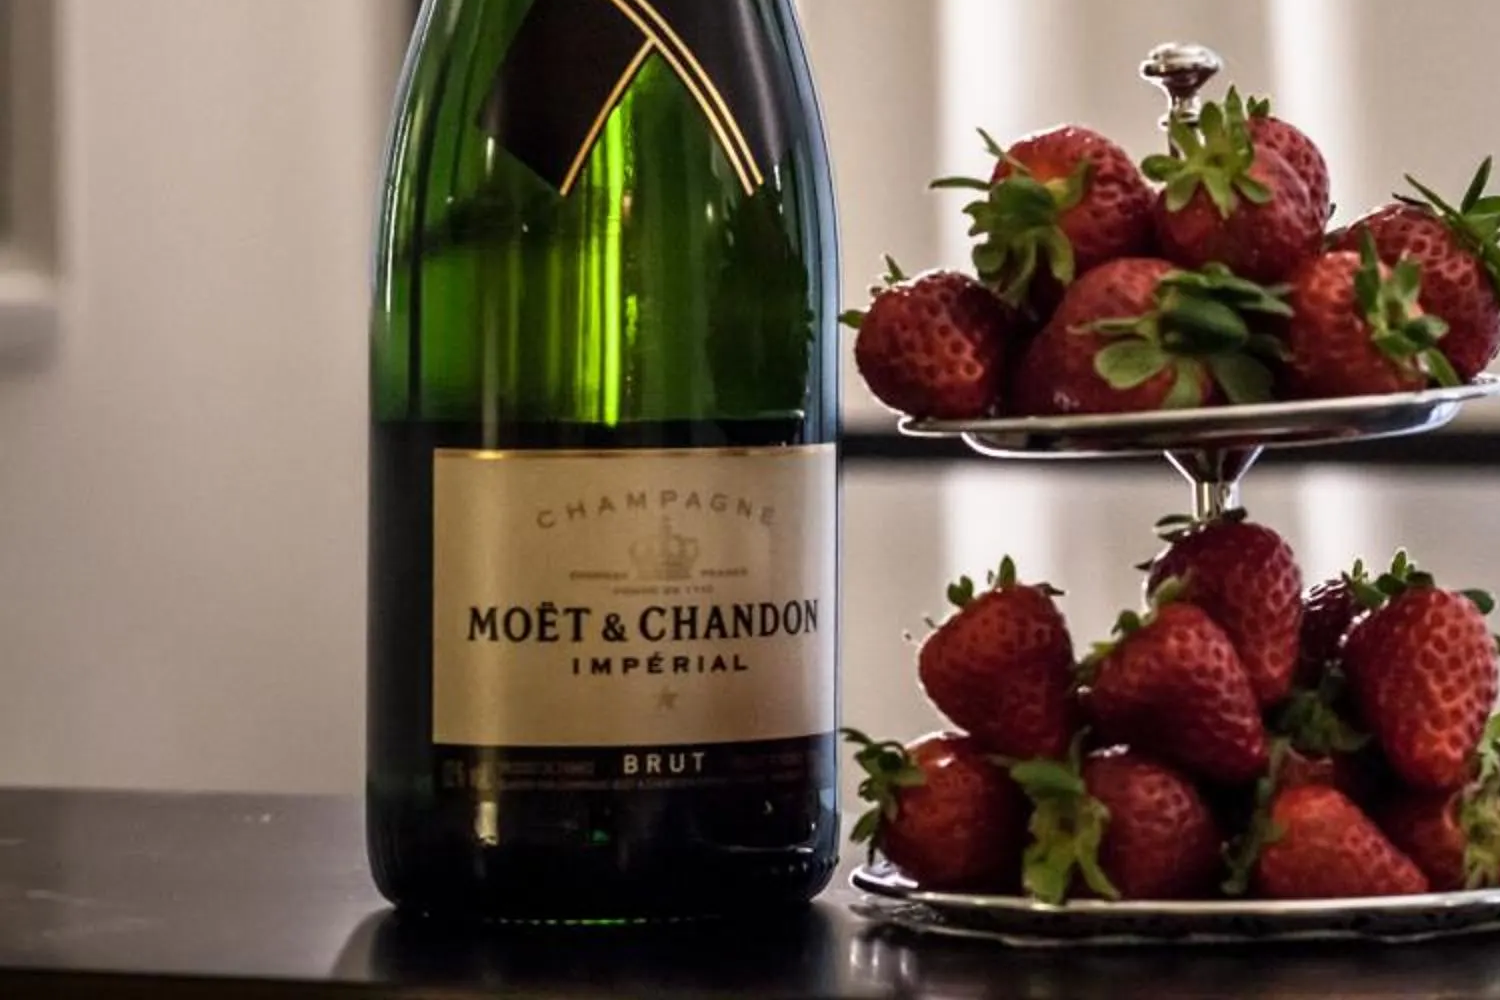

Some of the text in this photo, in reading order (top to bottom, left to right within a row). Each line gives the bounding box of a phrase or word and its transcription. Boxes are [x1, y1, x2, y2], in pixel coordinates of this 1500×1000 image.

[536, 489, 777, 531] CHAMPAGNE
[467, 599, 820, 643] MOËT & CHANDON
[572, 654, 749, 676] IMPÉRIAL
[623, 752, 706, 775] BRUT
